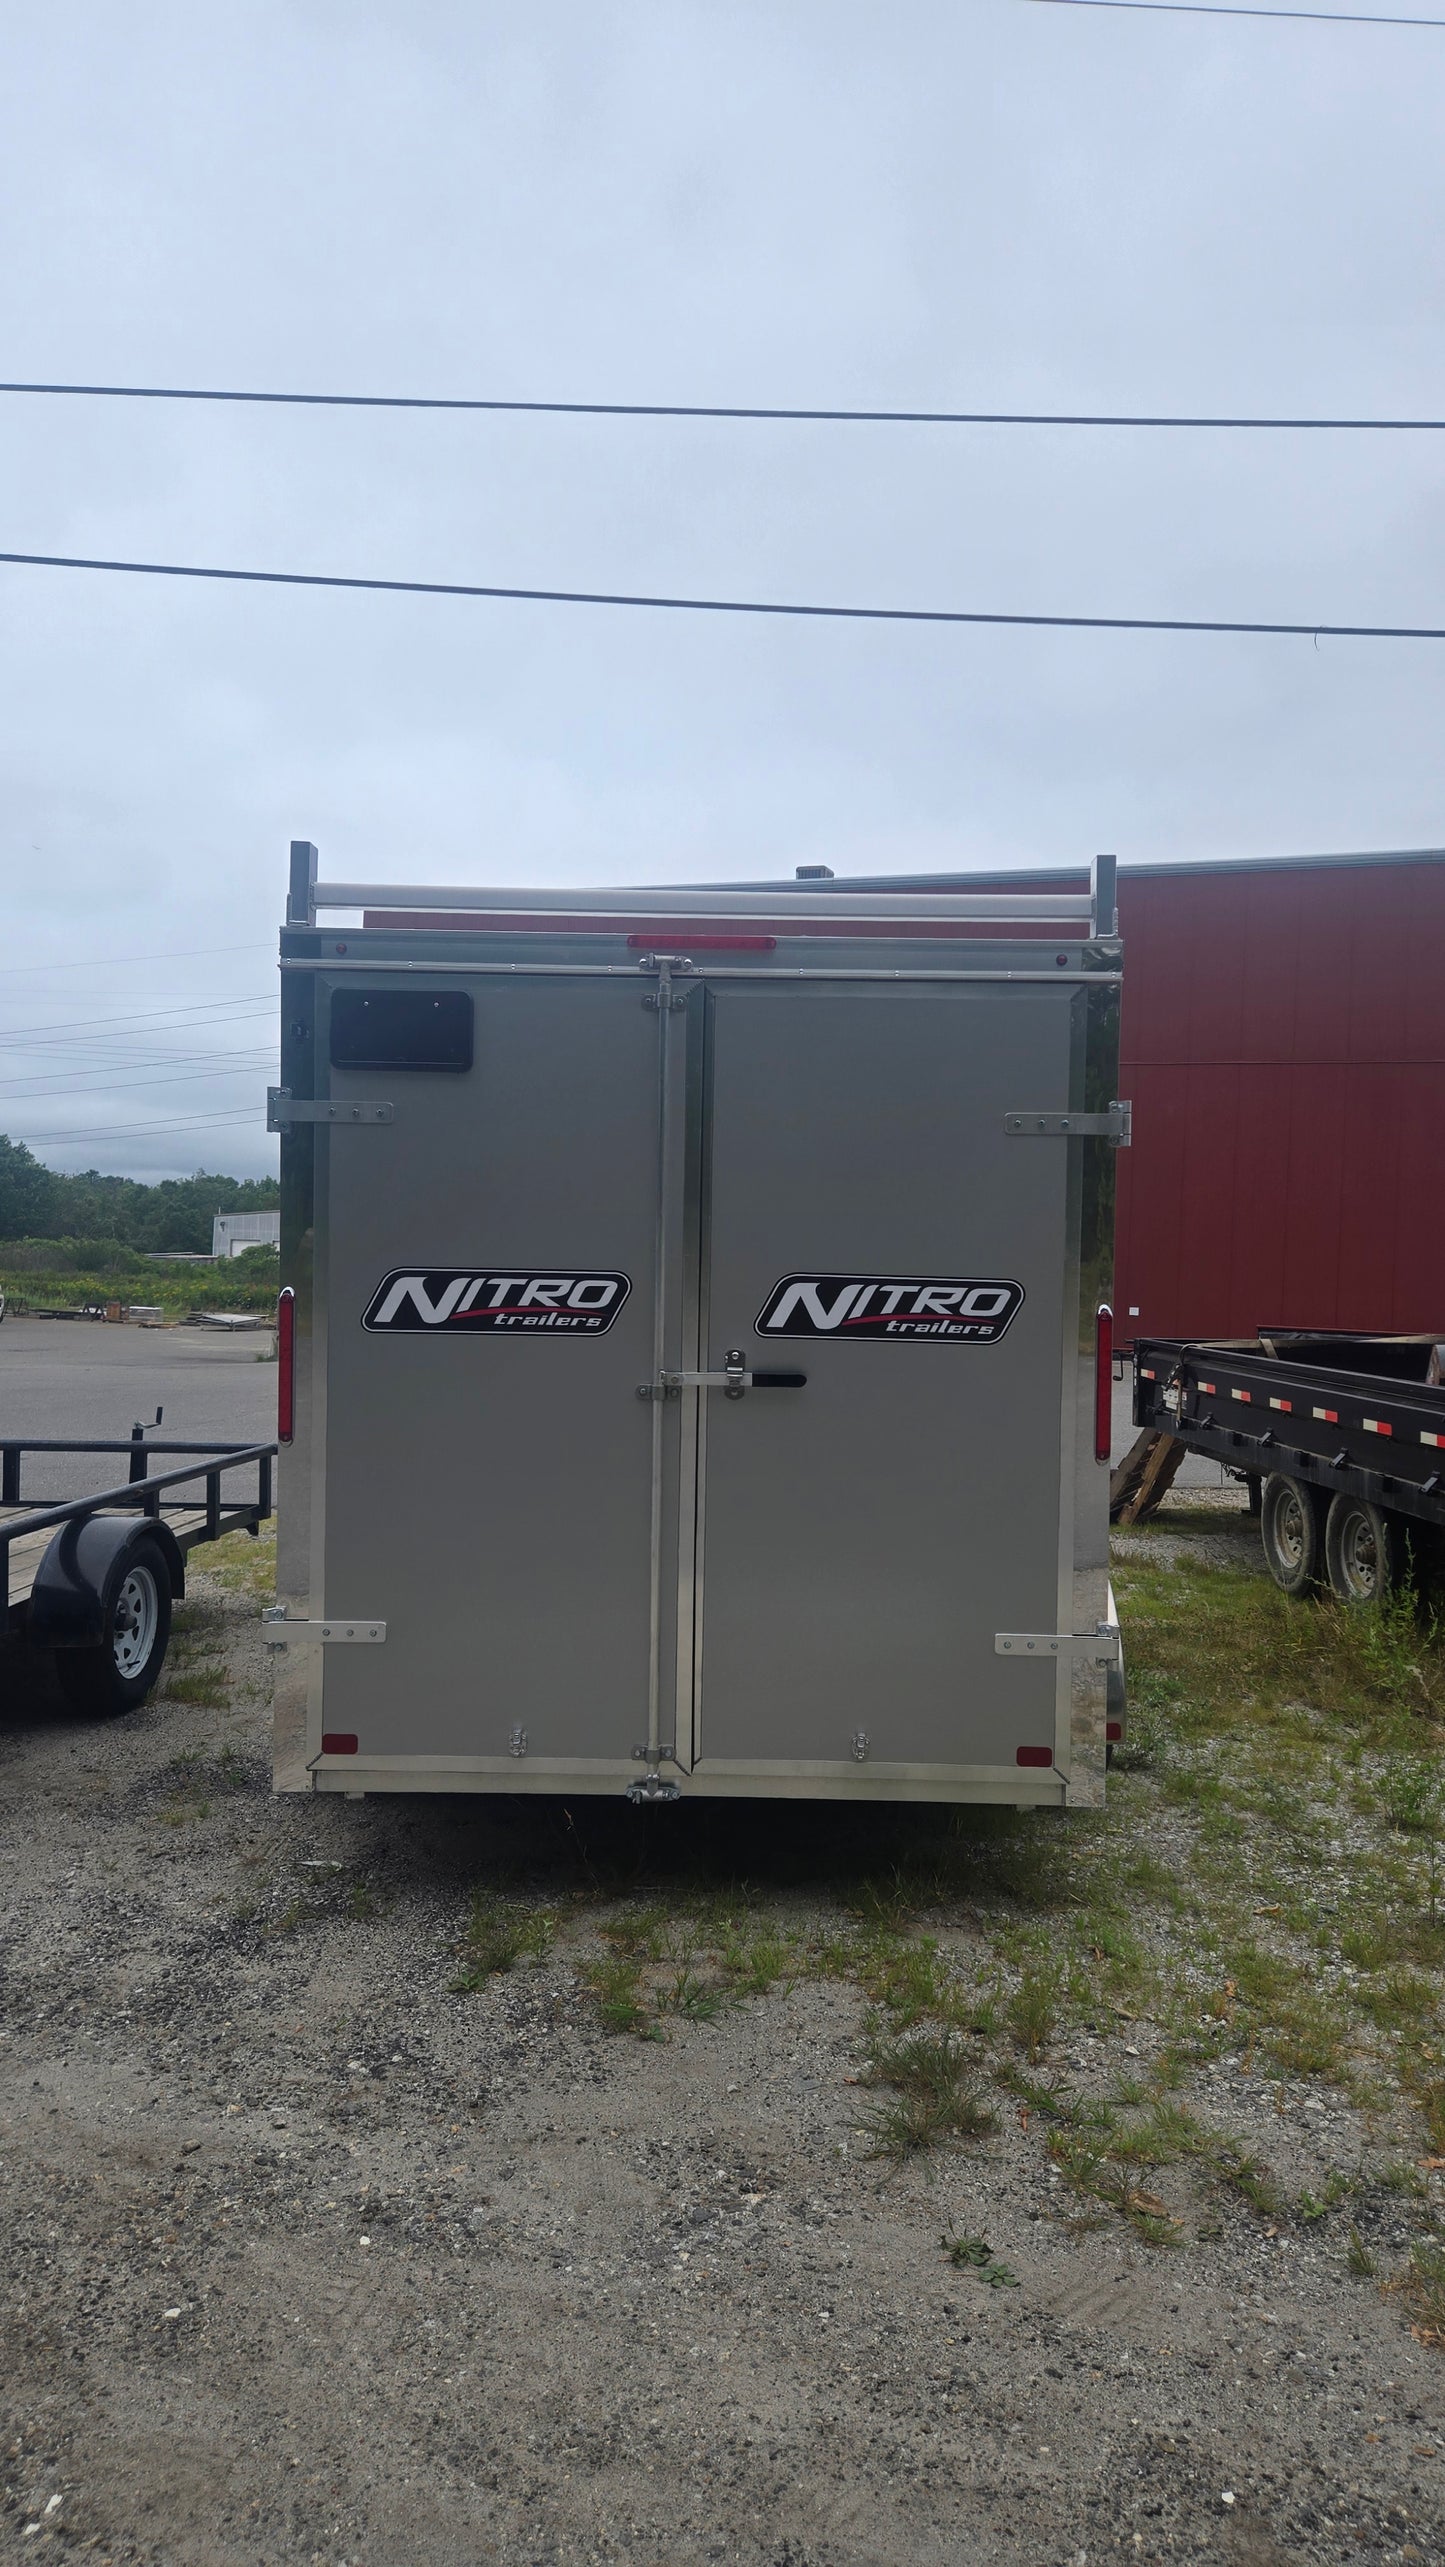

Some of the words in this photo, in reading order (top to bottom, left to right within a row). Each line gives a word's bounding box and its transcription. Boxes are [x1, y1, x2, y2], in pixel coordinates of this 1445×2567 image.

[373, 1276, 618, 1324] NITRO
[766, 1282, 1012, 1330] NITRO
[494, 1312, 602, 1327] trailers
[886, 1320, 994, 1335] trailers
